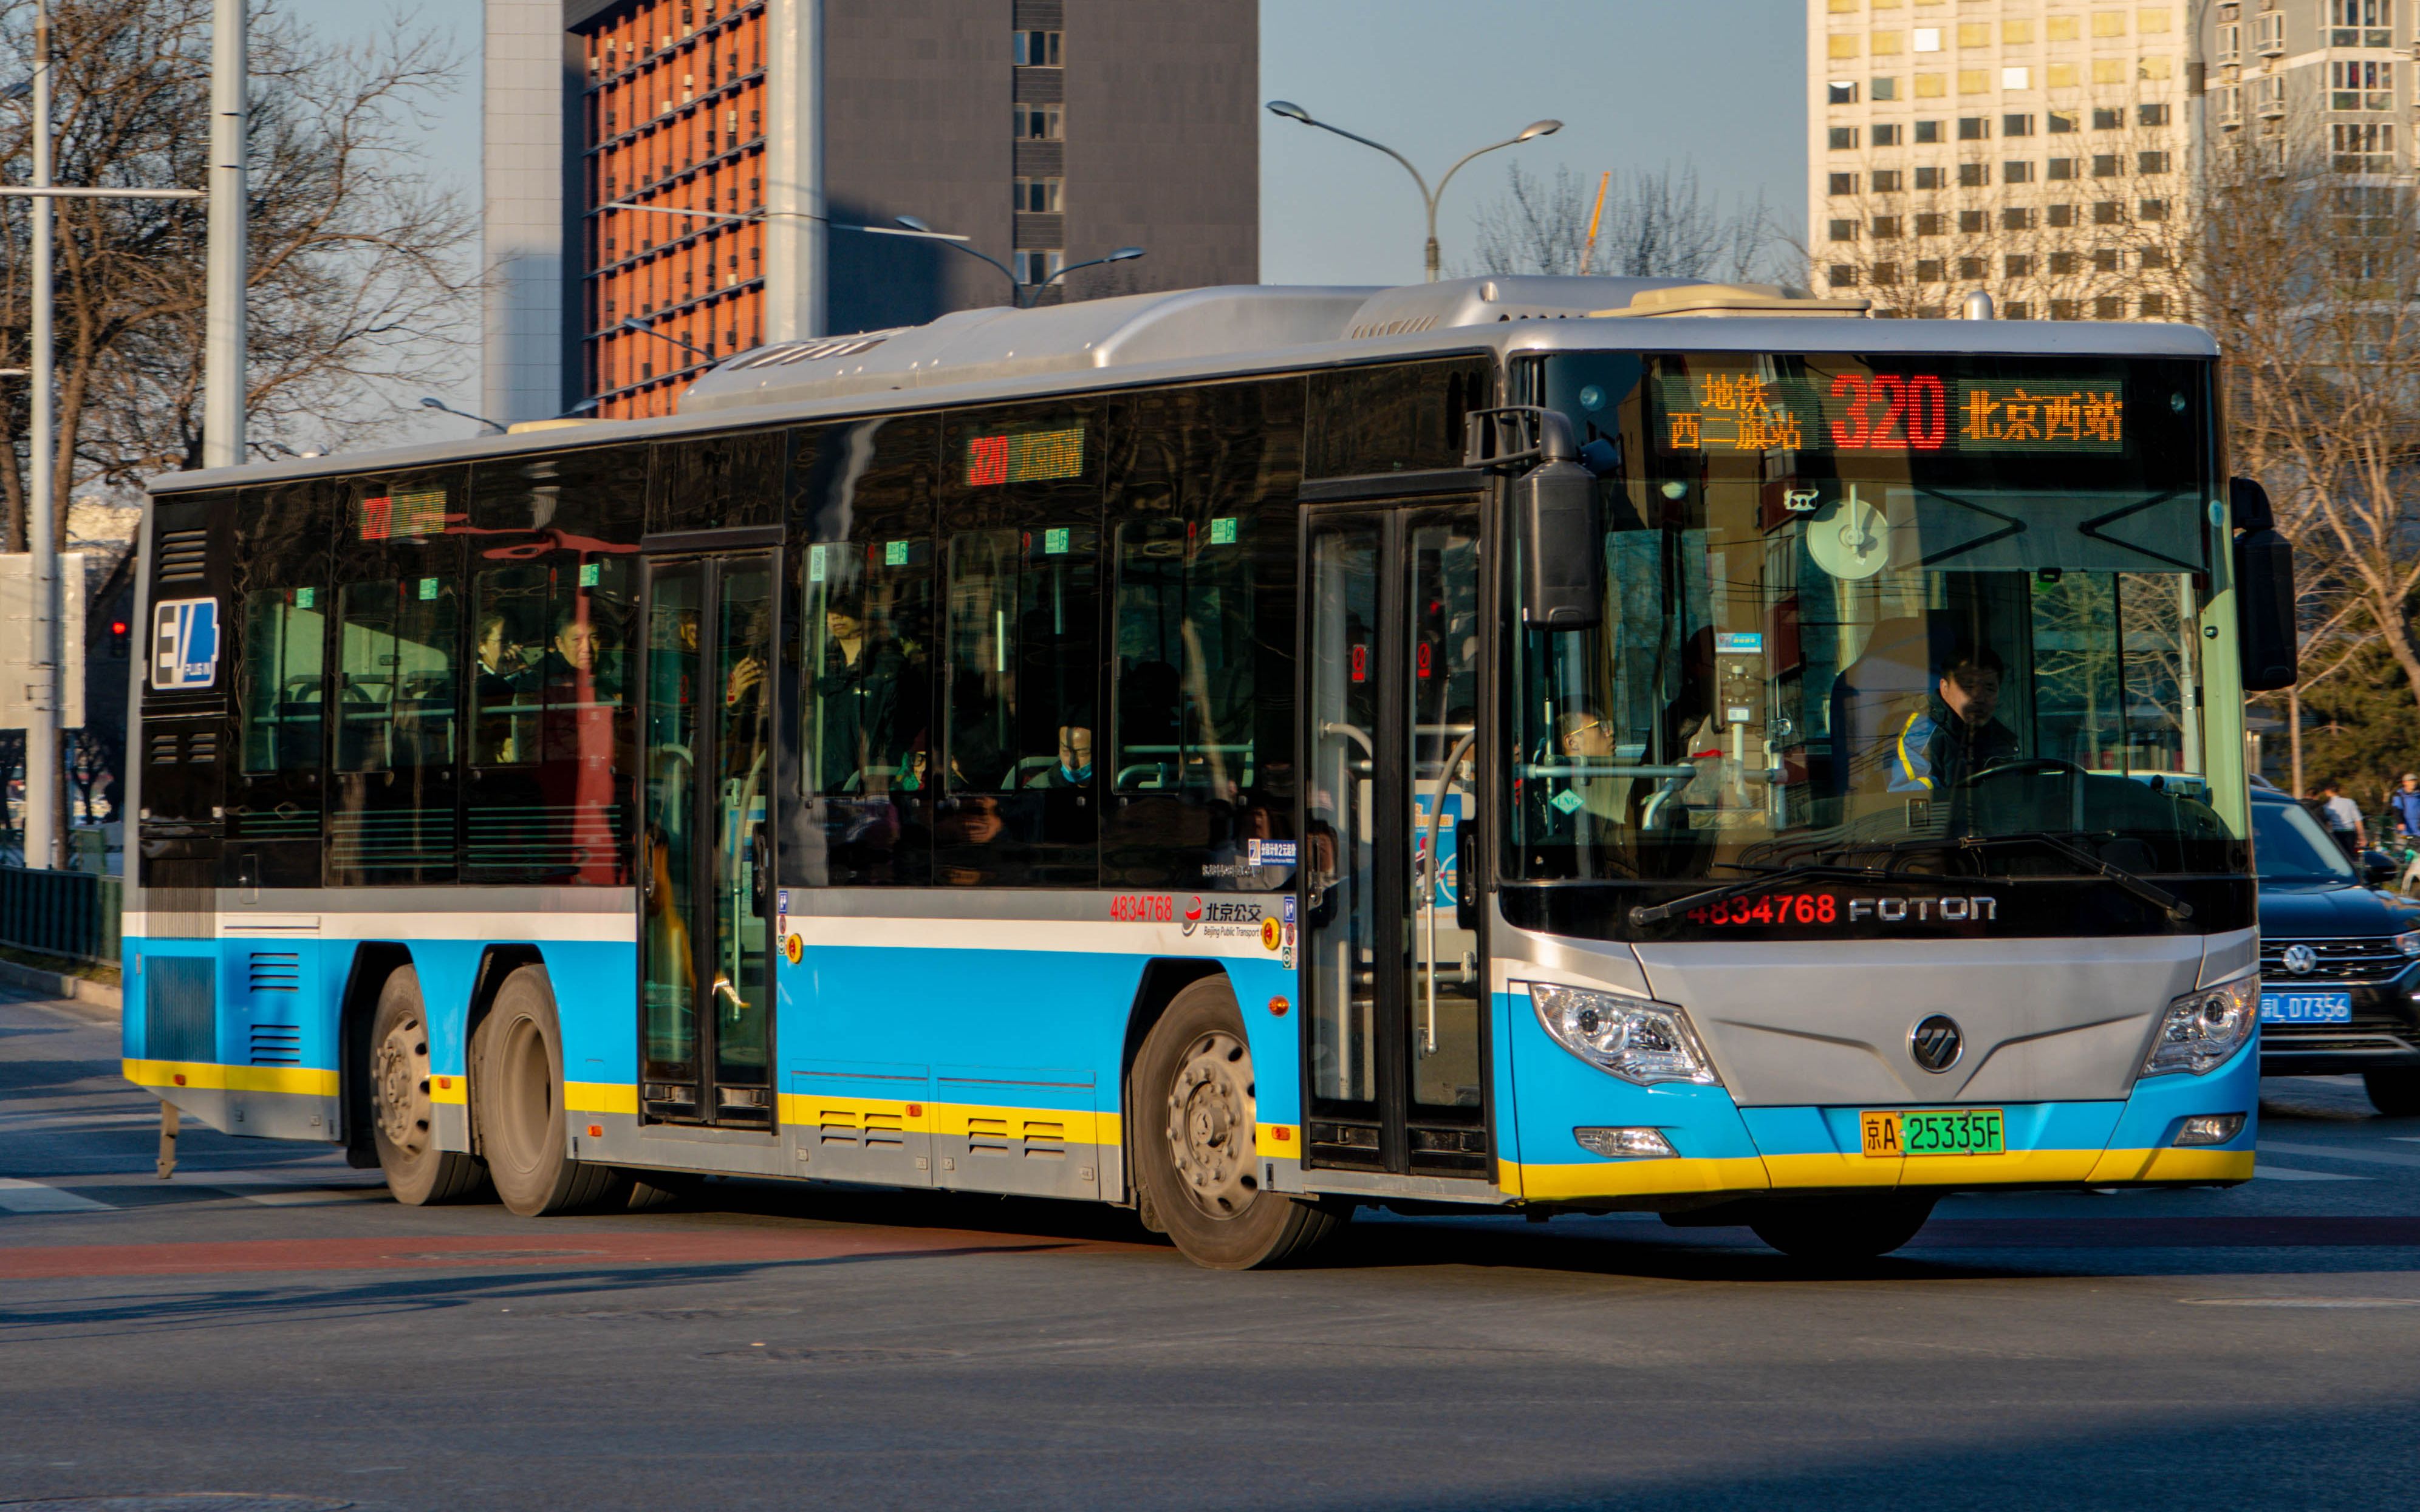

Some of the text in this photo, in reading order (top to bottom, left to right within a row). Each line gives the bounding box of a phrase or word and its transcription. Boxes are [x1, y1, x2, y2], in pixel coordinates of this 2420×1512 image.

[1700, 373, 1769, 412] 地铁
[1830, 374, 1946, 449] 320
[1959, 388, 2123, 441] 北京西站
[1667, 411, 1802, 450] 西二旗站
[970, 435, 1009, 486] 320
[1110, 895, 1173, 922] 4834768
[1205, 902, 1262, 922] 北京公交
[1687, 894, 1836, 924] 4834768
[1848, 896, 1997, 922] FOTON
[1203, 926, 1220, 939] Beijing
[1220, 927, 1235, 937] Public
[1236, 927, 1260, 938] Transport
[1909, 1116, 2000, 1149] 25335F
